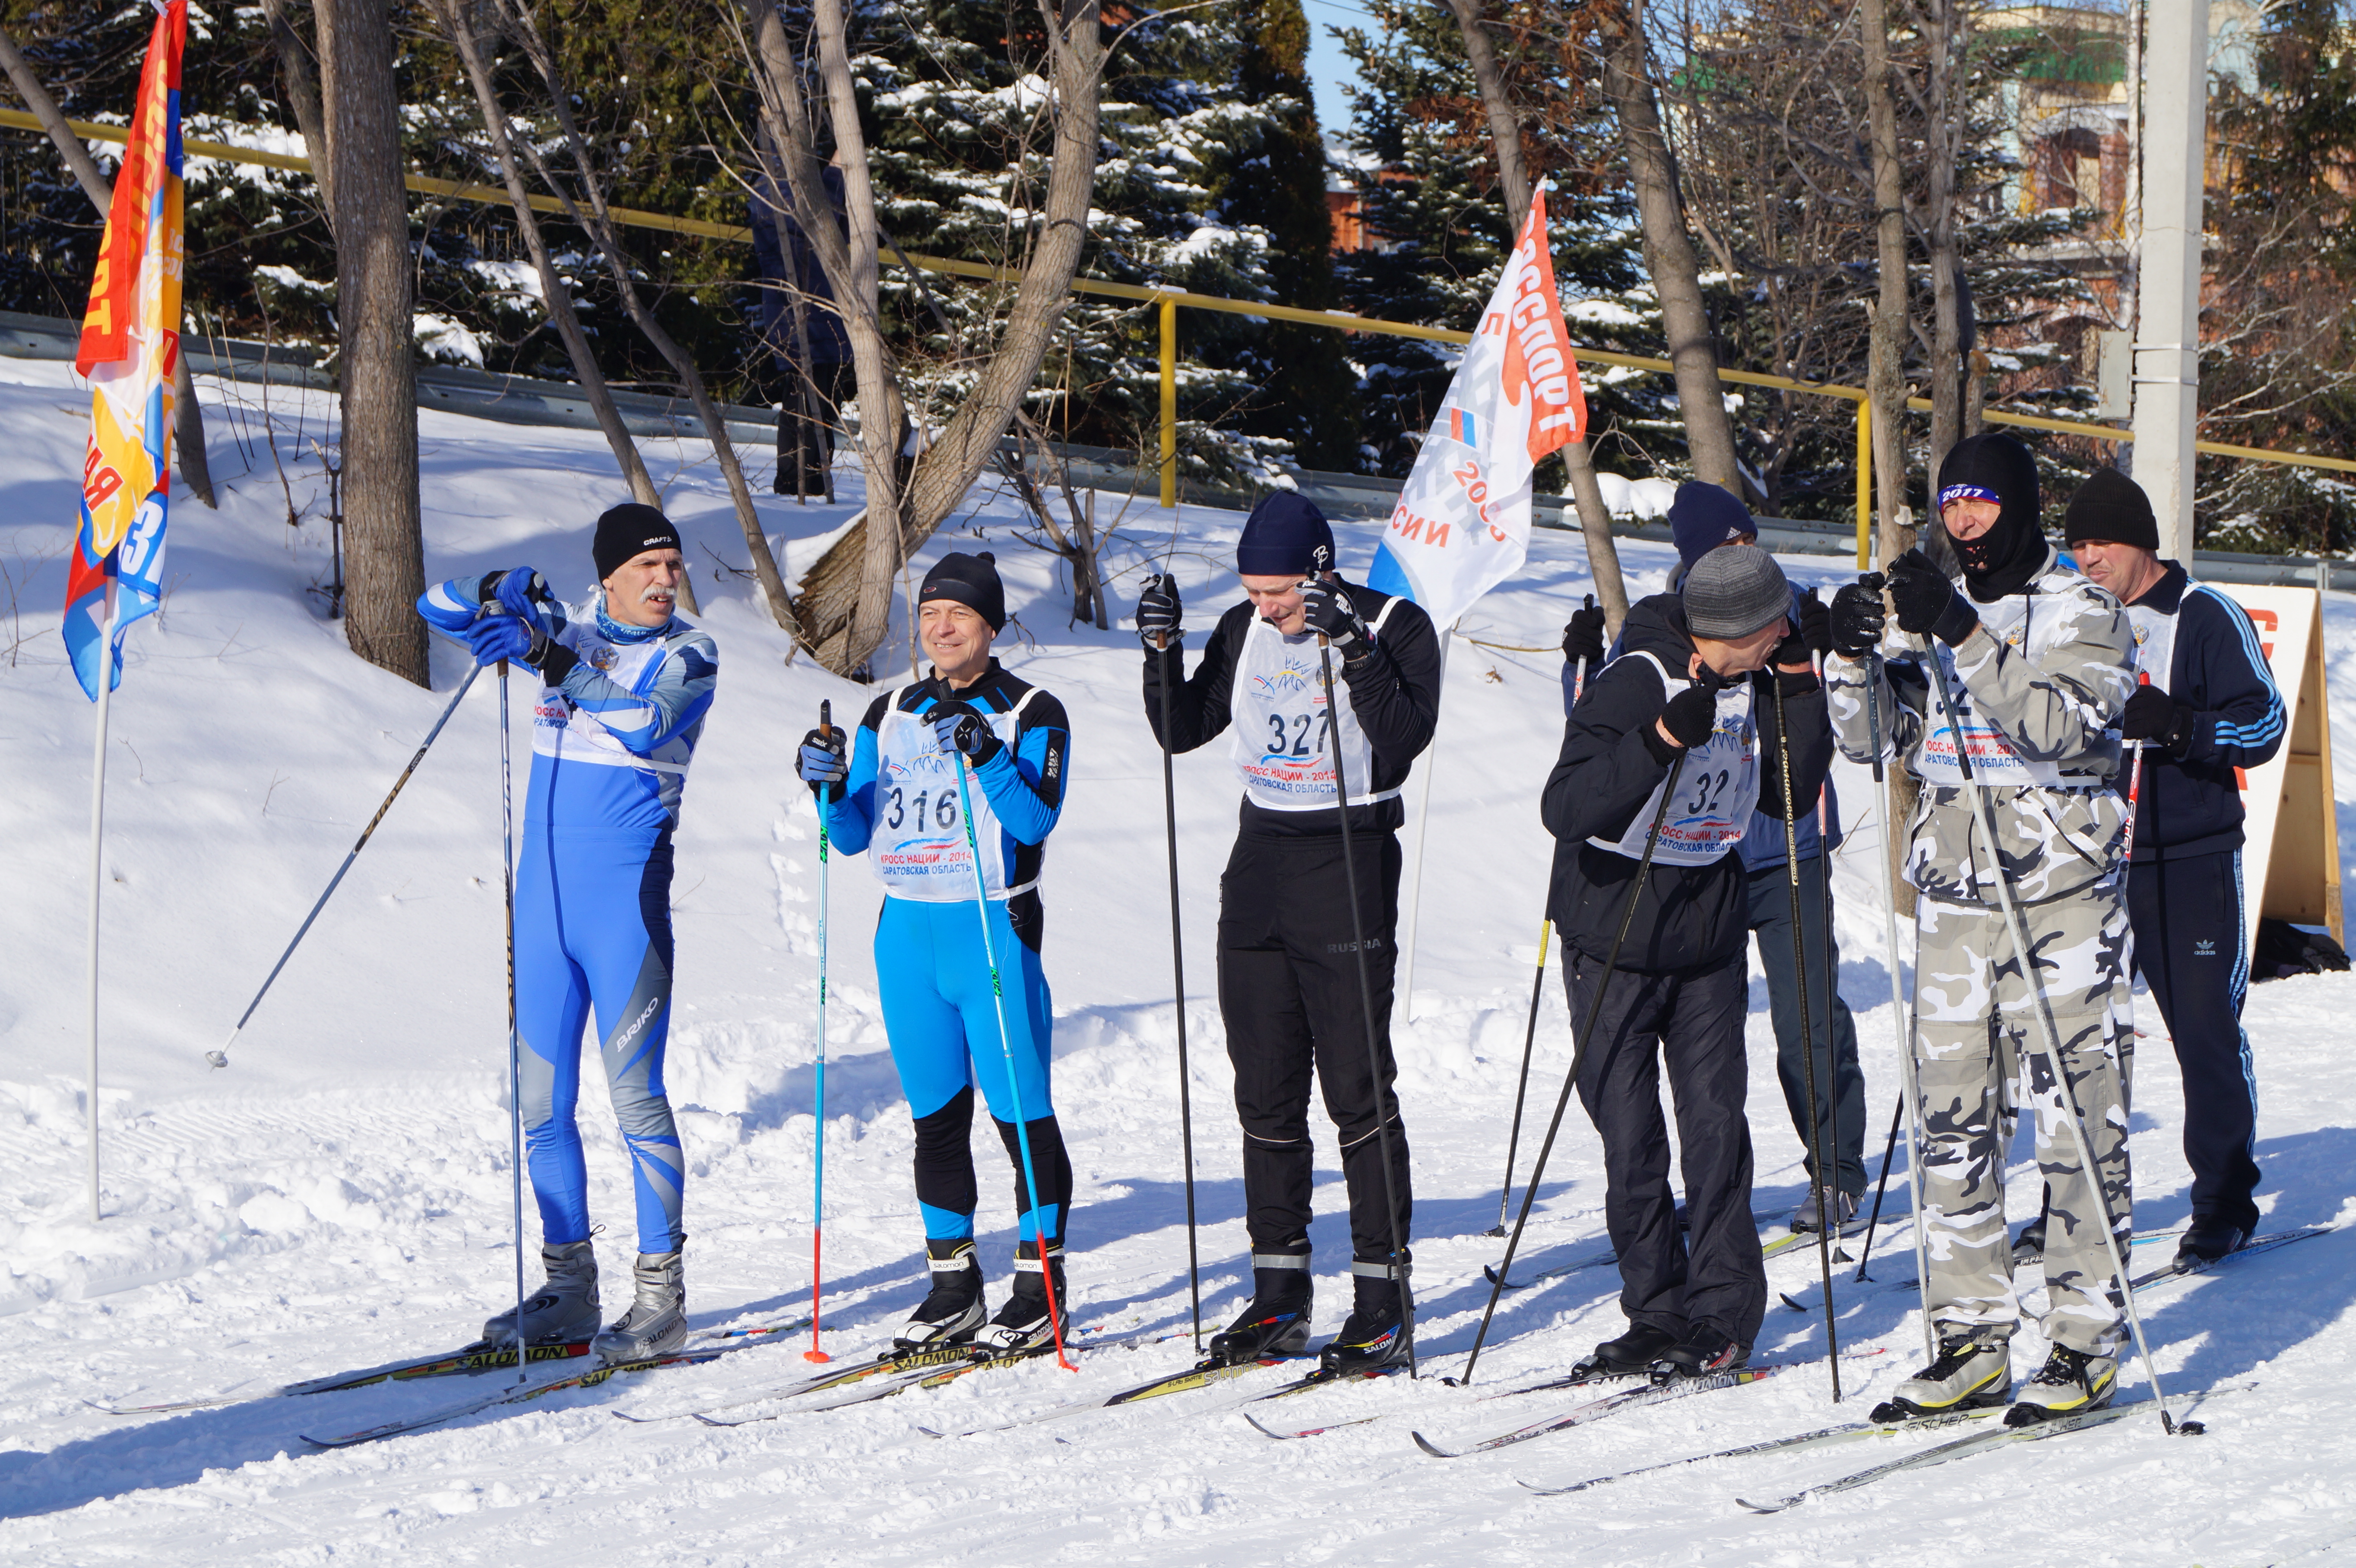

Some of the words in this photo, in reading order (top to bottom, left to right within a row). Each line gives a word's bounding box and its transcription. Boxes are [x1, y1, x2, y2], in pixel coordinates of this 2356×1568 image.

[1942, 488, 1984, 502] 2017
[643, 536, 667, 546] CRAFT
[1335, 592, 1348, 607] WIND
[1267, 708, 1330, 756] 327
[1979, 757, 2024, 768] ОБЛАСТЬ
[1271, 768, 1303, 782] НАЦИИ
[1312, 769, 1336, 781] 2014
[1249, 774, 1292, 792] САРАТОВСКАЯ
[1295, 784, 1336, 793] ОБЛАСТЬ
[888, 787, 957, 832] 316
[1684, 830, 1711, 842] НАЦИИ
[1718, 830, 1741, 840] 2014
[880, 854, 905, 864] КРОСС
[906, 853, 940, 865] НАЦИИ
[949, 851, 971, 862] 2014
[883, 865, 929, 876] САРАТОВСКАЯ
[932, 863, 972, 875] ОБЛАСТЬ
[616, 997, 659, 1053] BRIKO
[1363, 1332, 1399, 1354] SALOMO
[893, 1348, 969, 1372] SALOMON
[1907, 1414, 1969, 1433] FISCHER
